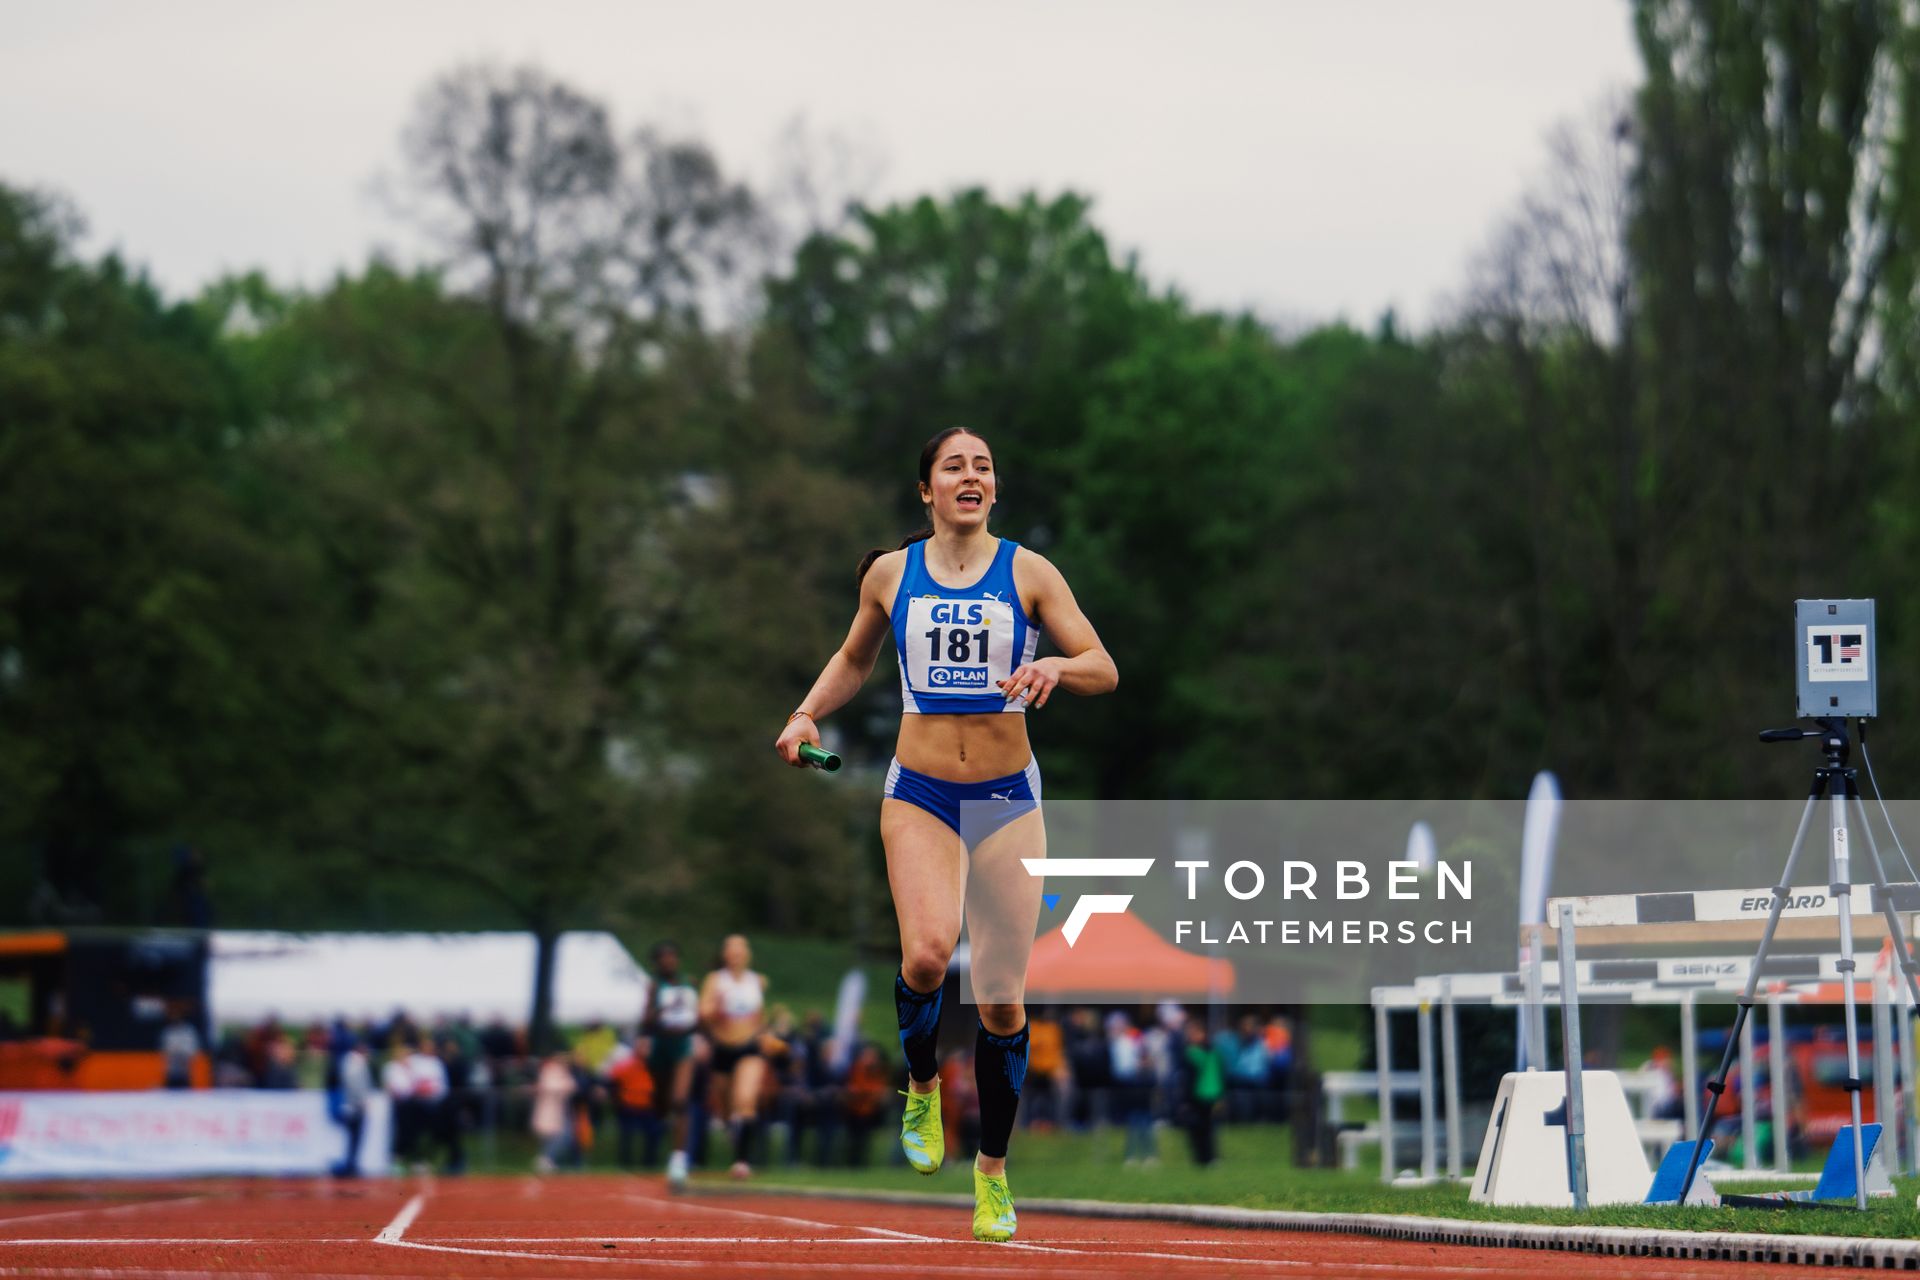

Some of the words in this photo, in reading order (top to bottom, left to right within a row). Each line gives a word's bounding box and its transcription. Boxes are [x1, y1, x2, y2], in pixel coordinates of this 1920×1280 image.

[925, 627, 989, 662] 181
[953, 670, 986, 681] PLAN
[1672, 963, 1736, 975] BENZ
